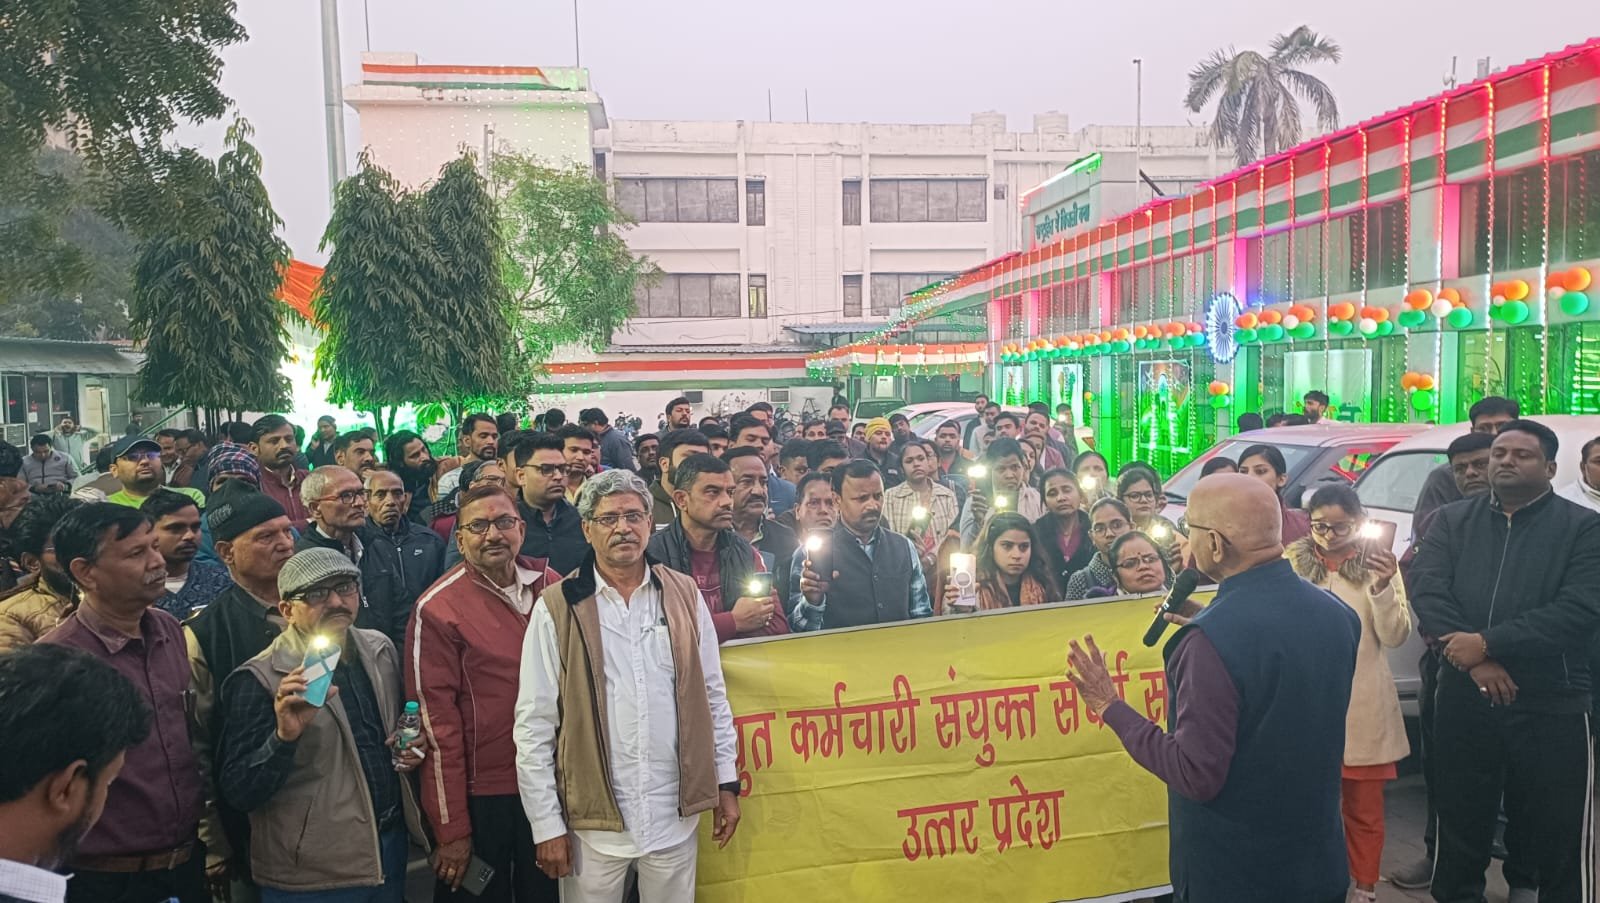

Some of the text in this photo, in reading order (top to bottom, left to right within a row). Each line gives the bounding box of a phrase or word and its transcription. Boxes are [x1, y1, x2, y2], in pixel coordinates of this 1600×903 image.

[787, 674, 920, 763] कर्मचारी
[930, 665, 1040, 767] संयुक्त
[897, 775, 1065, 862] उत्तर प्रदेश
